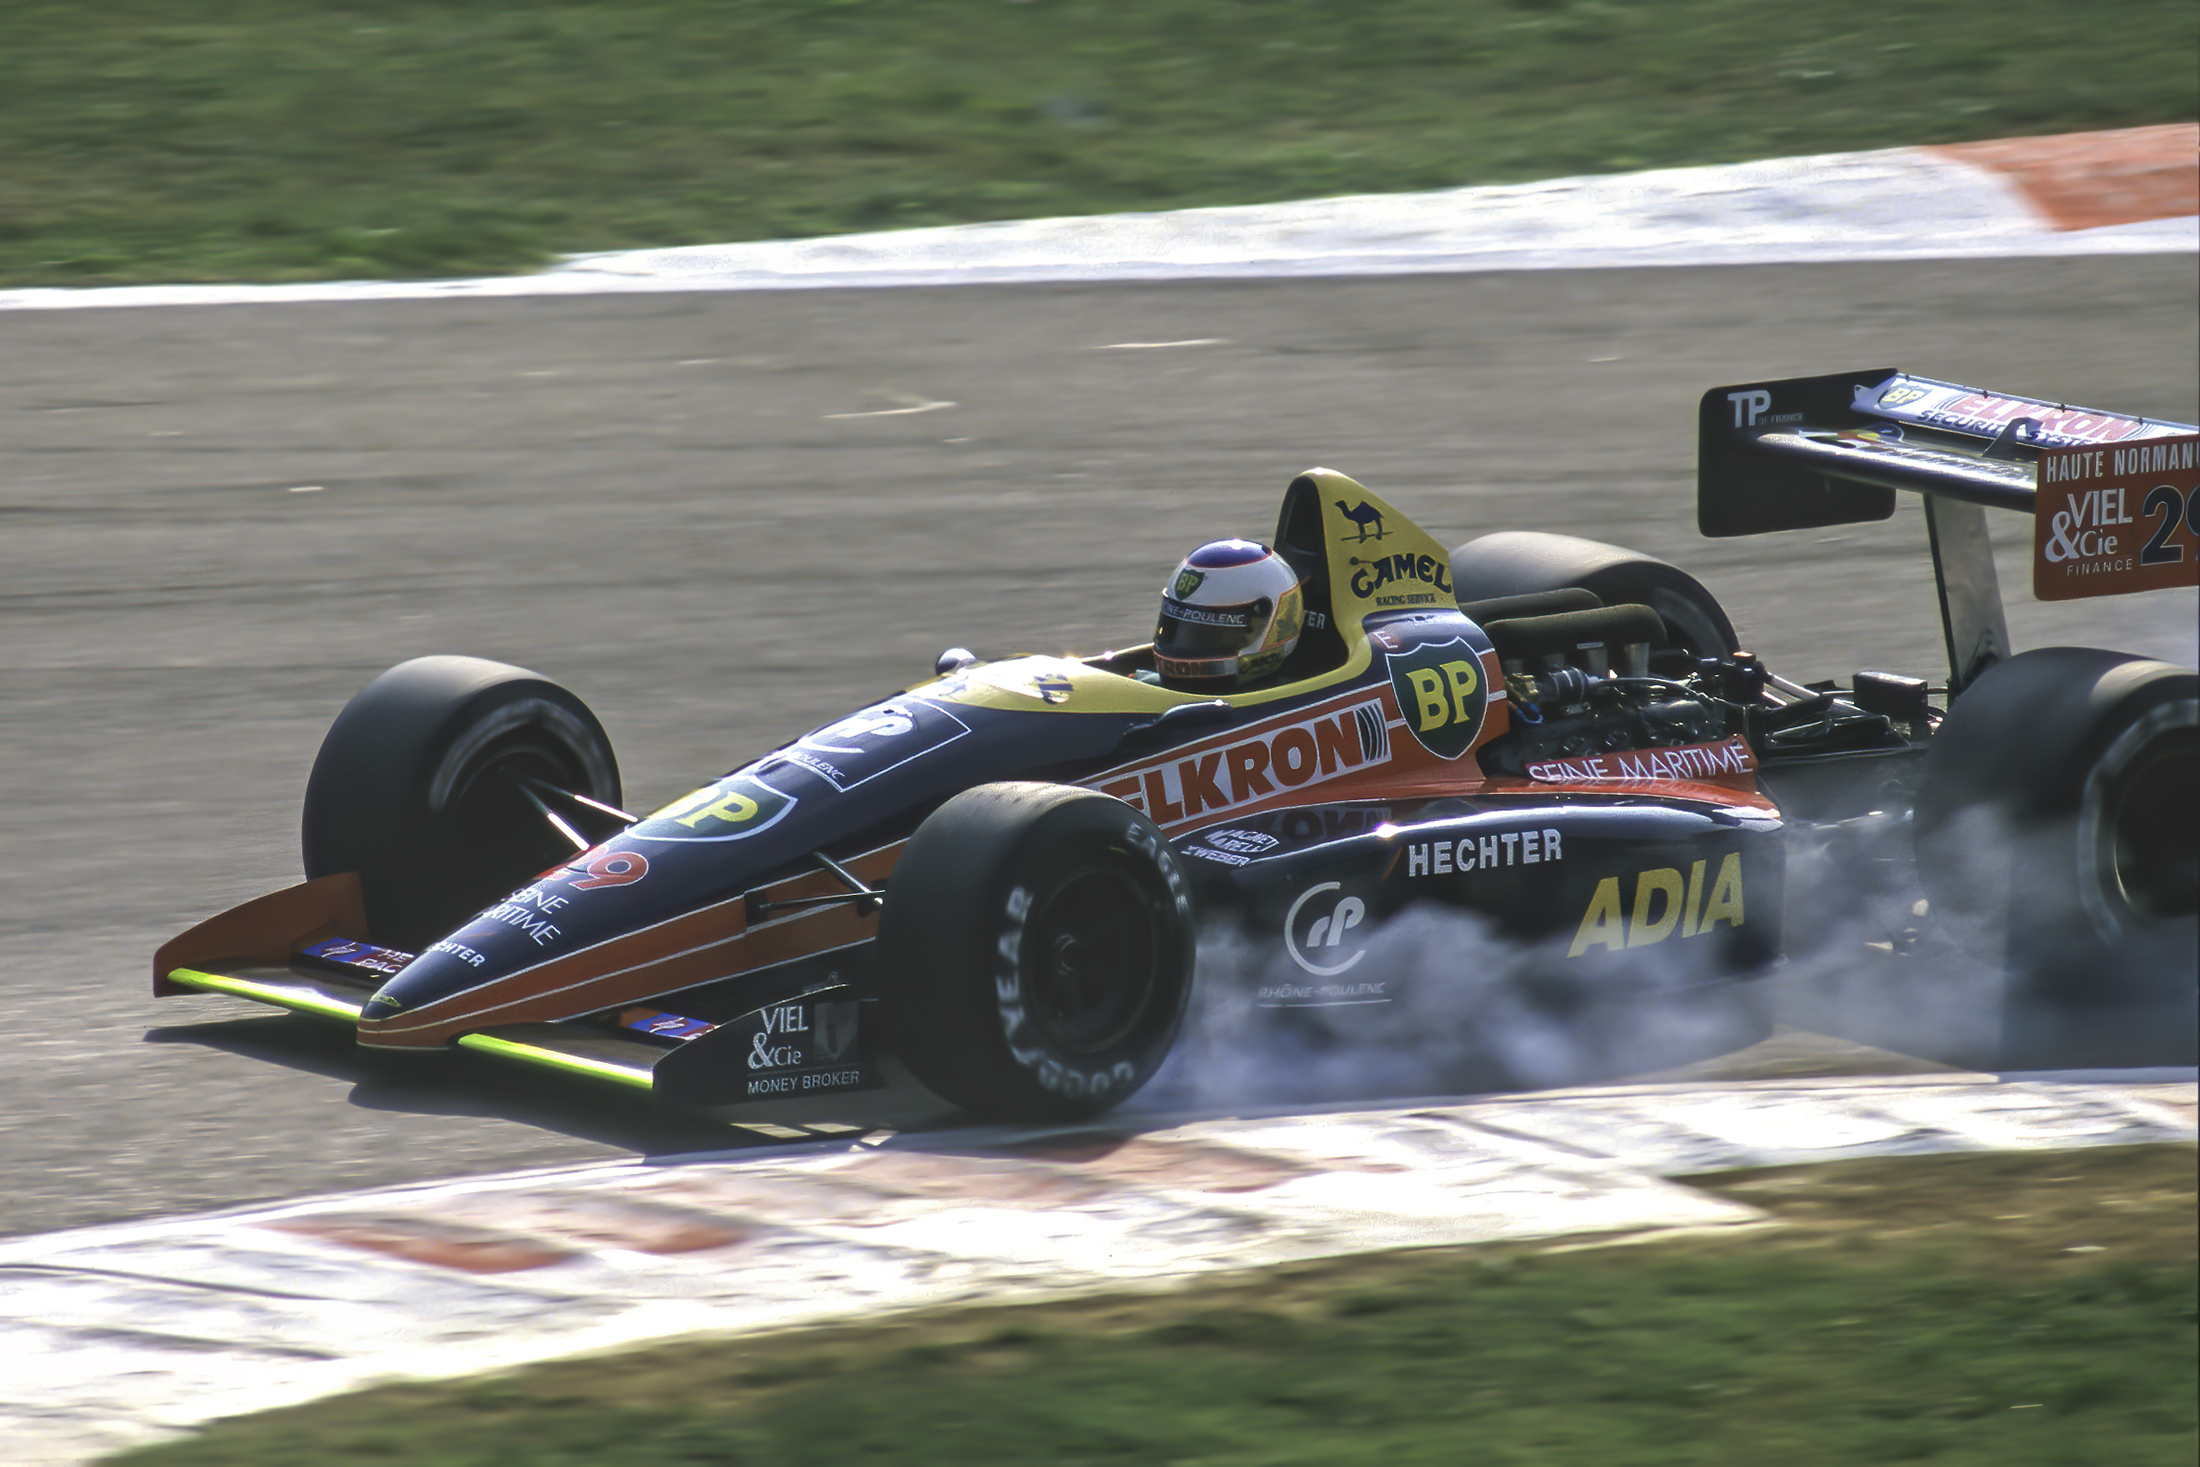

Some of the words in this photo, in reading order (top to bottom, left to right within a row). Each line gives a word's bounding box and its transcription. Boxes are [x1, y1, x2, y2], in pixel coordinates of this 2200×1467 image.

[1727, 389, 1771, 428] TP
[1880, 386, 1924, 410] BP
[2047, 451, 2104, 482] HAUTE
[2114, 442, 2199, 476] NORMAN
[2067, 488, 2133, 528] VIEL
[1177, 572, 1200, 595] BP
[1350, 552, 1453, 599] CAMEL
[2067, 558, 2133, 577] FINANCE
[1166, 603, 1246, 625] NE-POULENC
[1405, 660, 1478, 733] BP
[1528, 758, 1609, 783] SEINE
[1617, 743, 1754, 780] MARITIME
[1408, 828, 1562, 877] HECHTER
[1567, 852, 1745, 959] ADIA
[760, 1005, 809, 1034] VIEL
[747, 1077, 797, 1095] MONEY
[802, 1070, 860, 1090] BROKER
